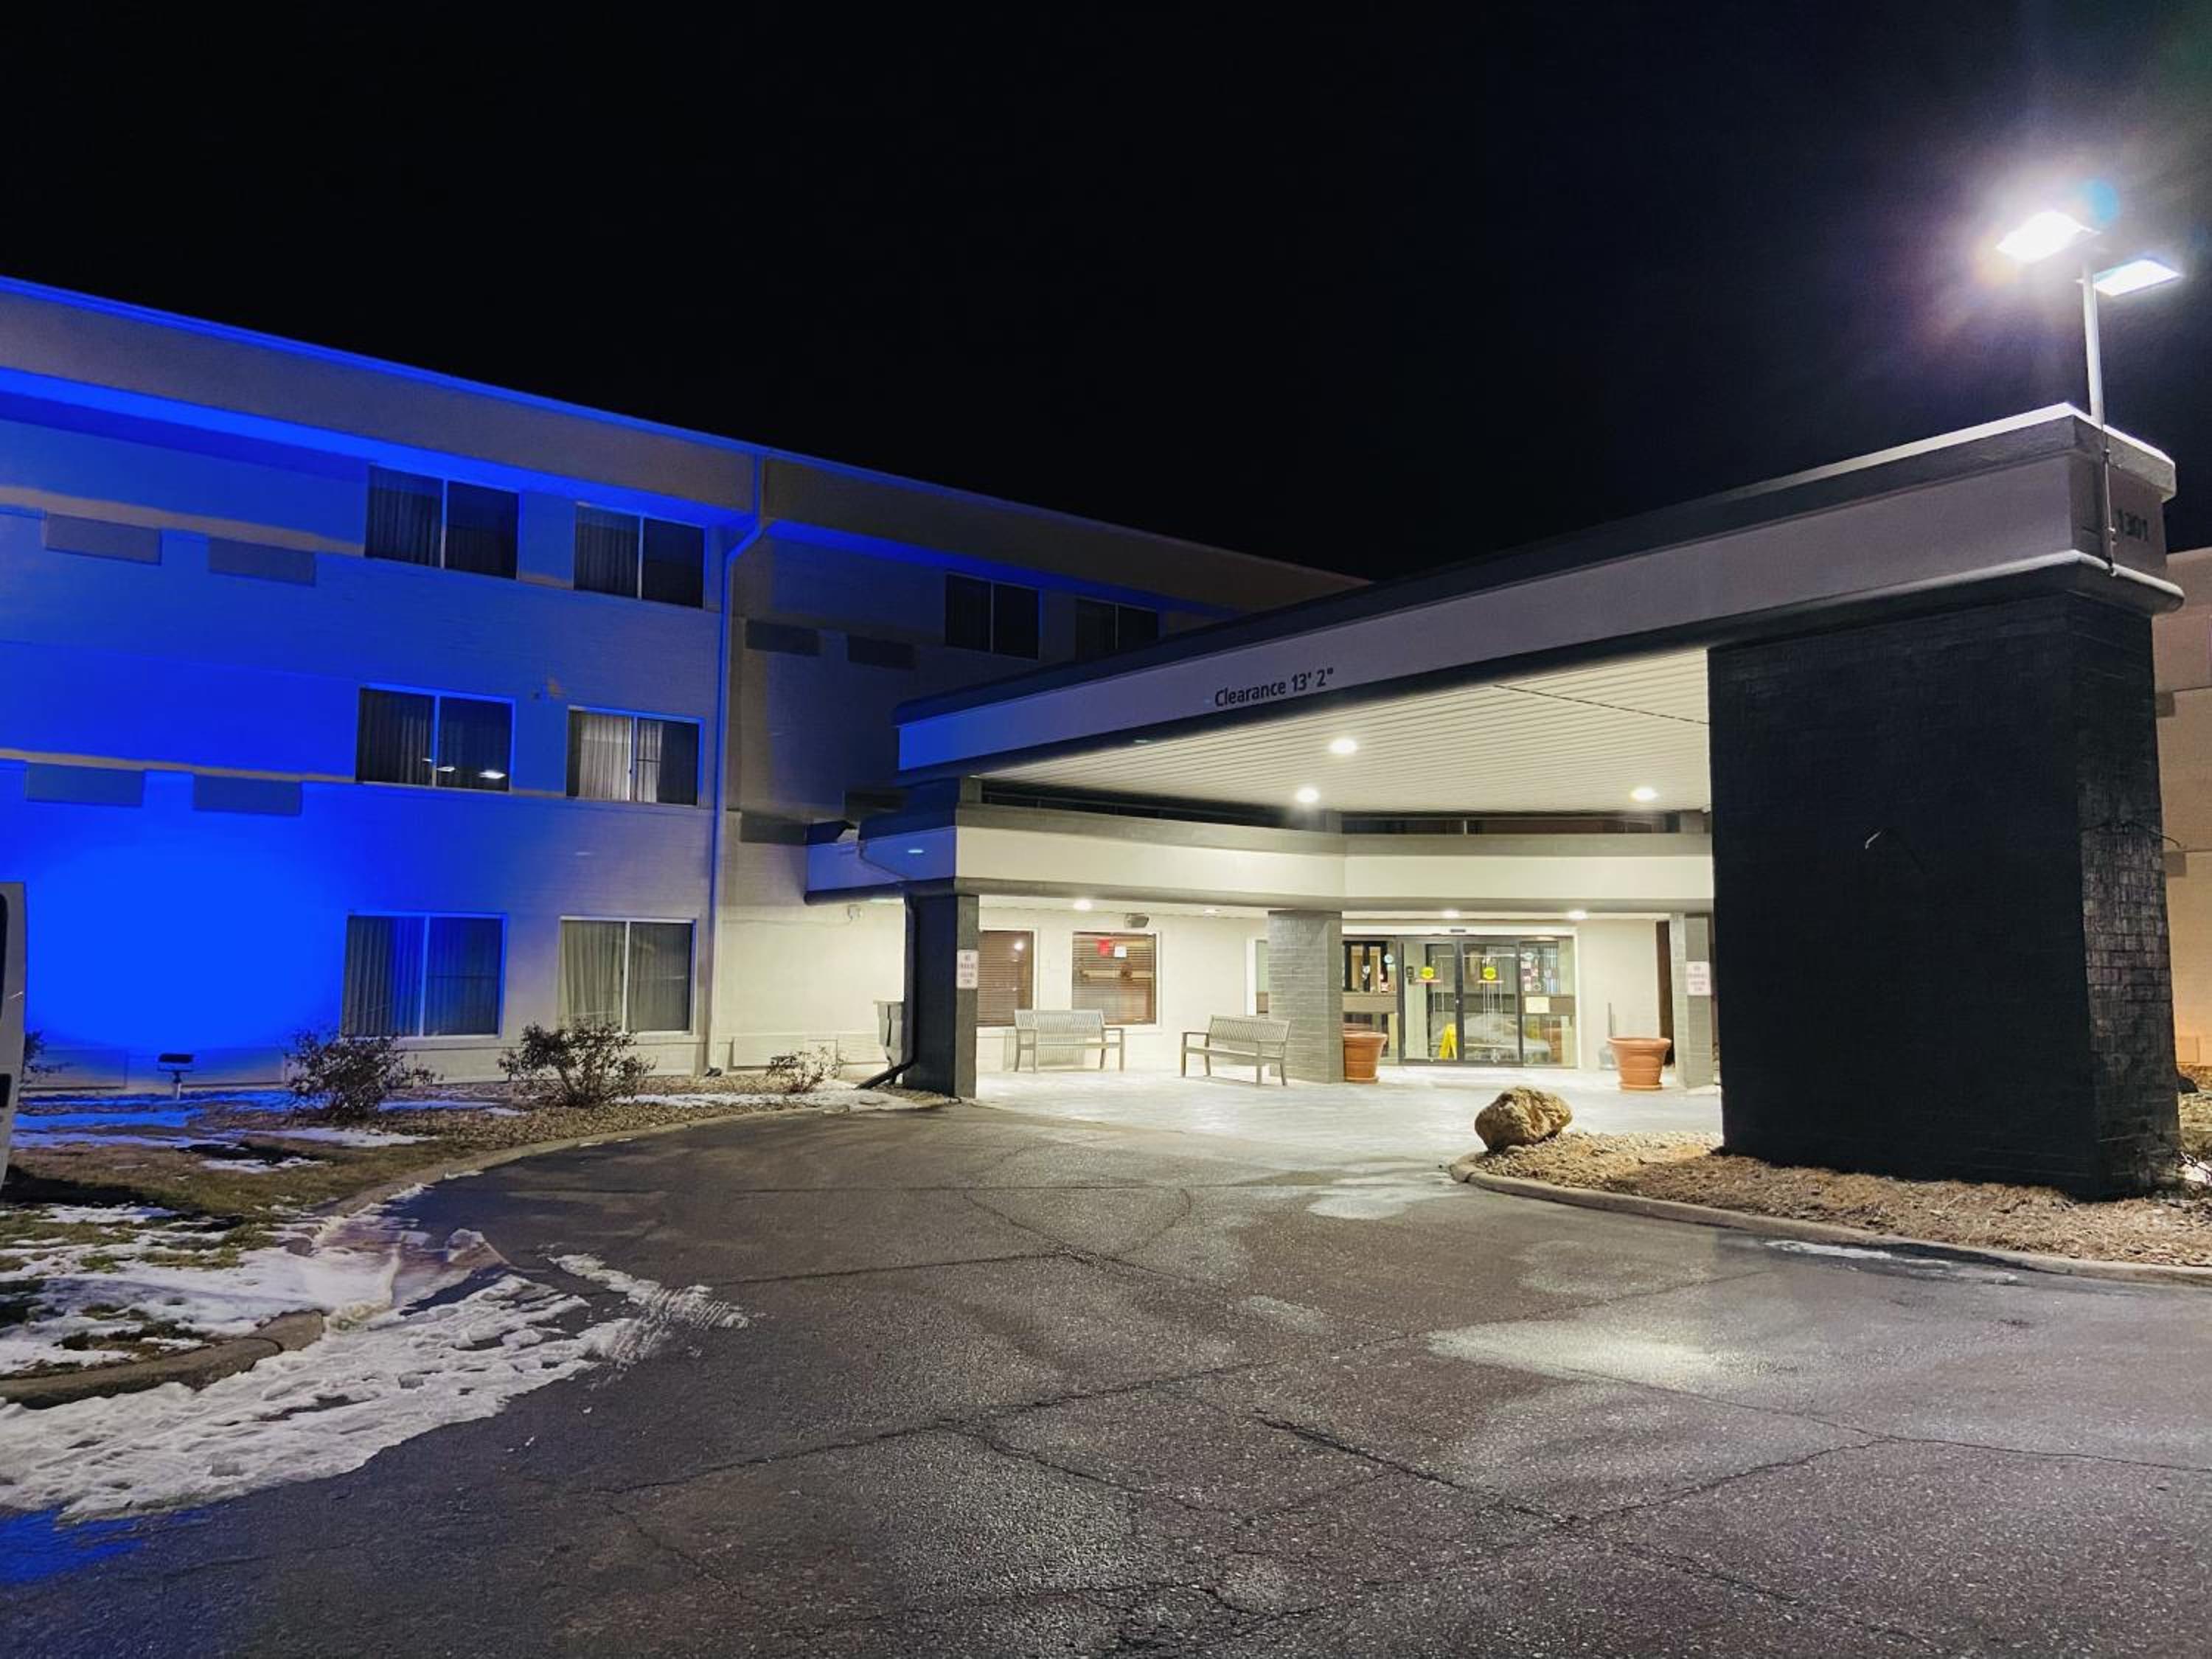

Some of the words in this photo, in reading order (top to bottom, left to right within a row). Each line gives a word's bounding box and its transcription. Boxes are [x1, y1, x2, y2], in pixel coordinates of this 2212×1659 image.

[1215, 681, 1286, 706] Clearance
[1292, 672, 1312, 692] 13'
[1317, 667, 1334, 687] 2"
